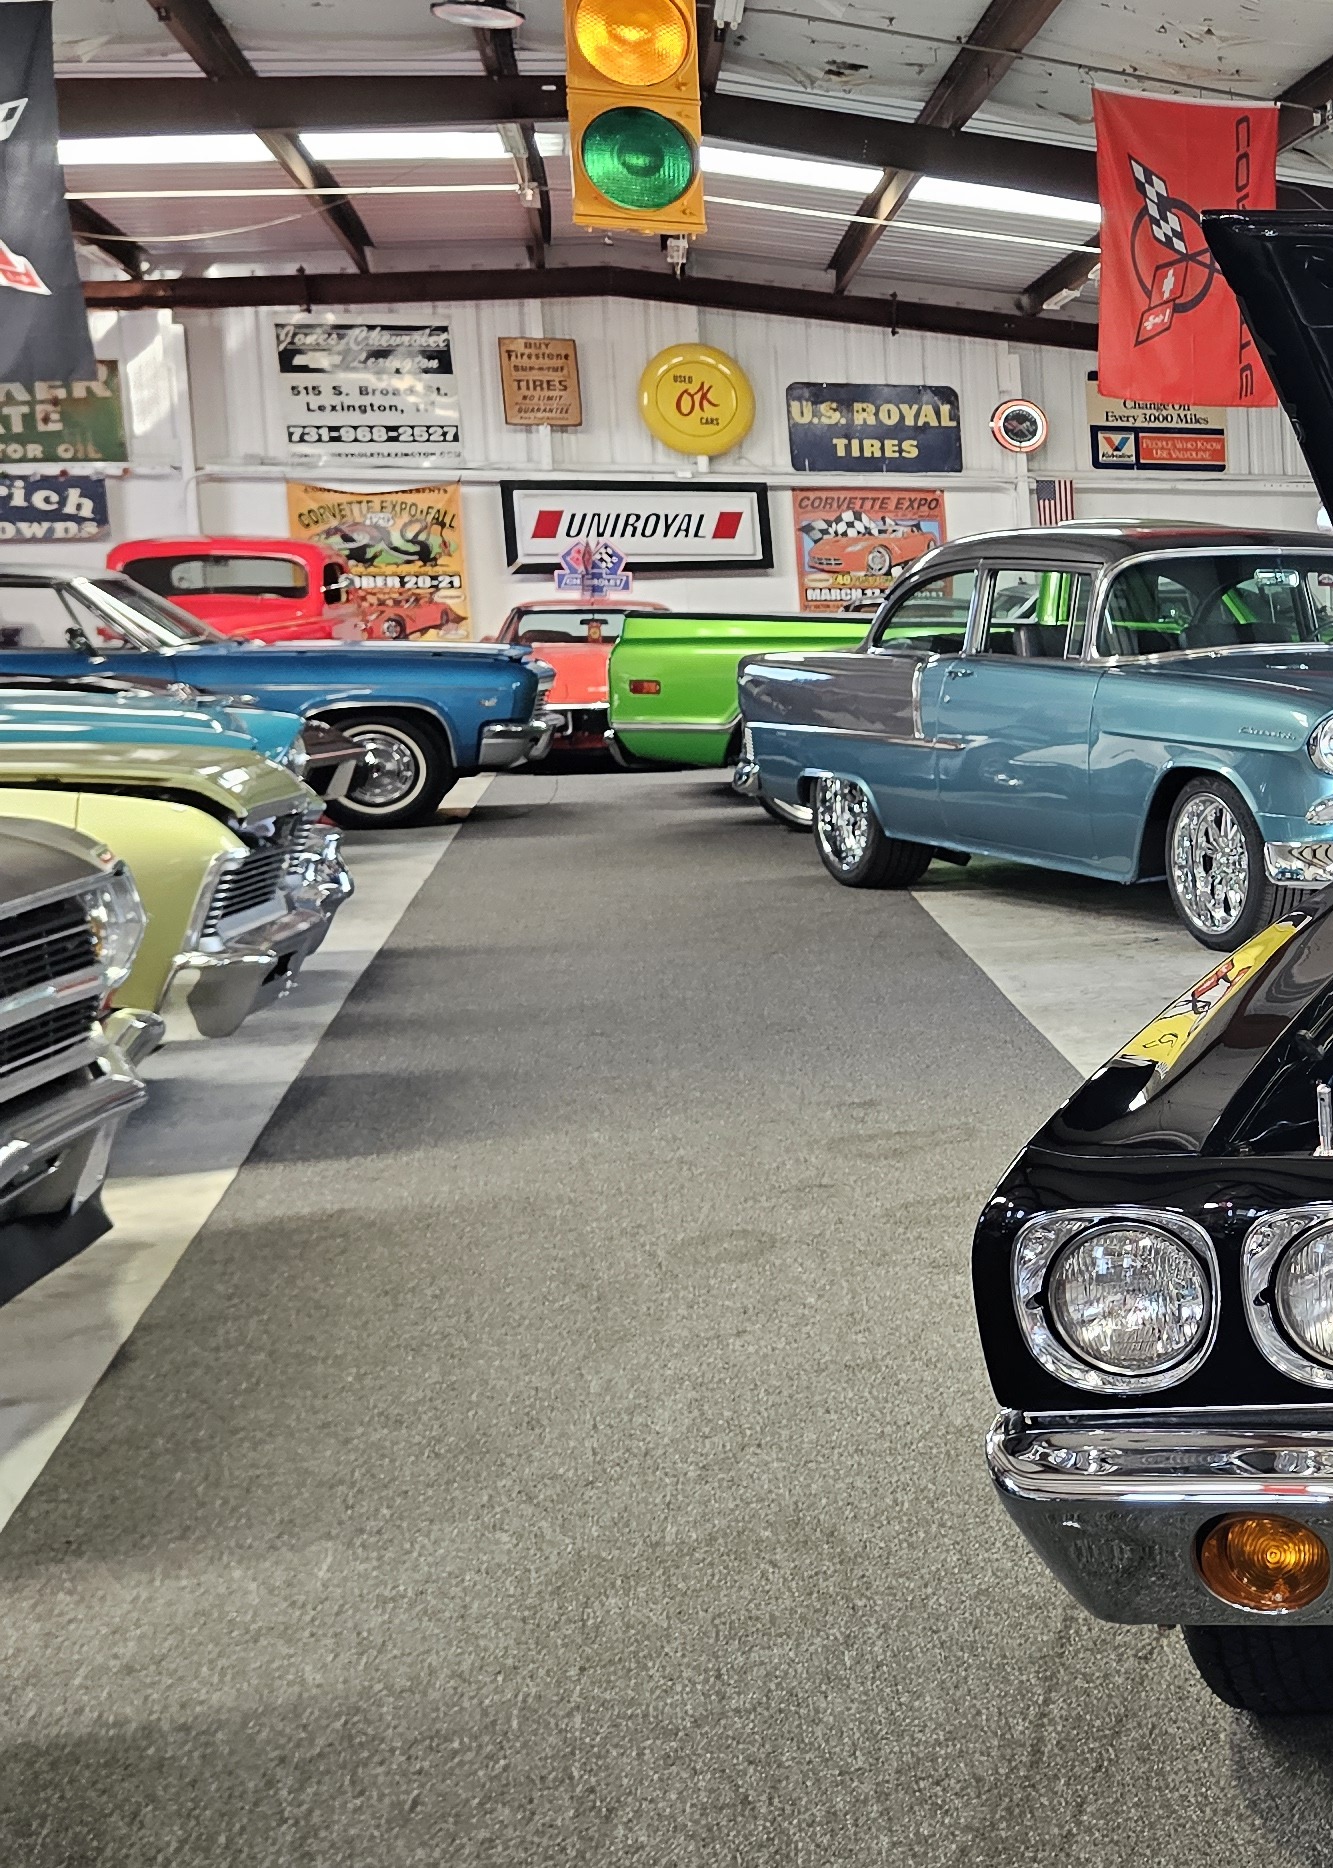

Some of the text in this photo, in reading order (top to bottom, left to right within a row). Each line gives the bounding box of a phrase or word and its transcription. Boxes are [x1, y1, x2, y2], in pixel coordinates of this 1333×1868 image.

[523, 341, 551, 350] BUY
[505, 349, 570, 362] Firestone
[513, 378, 569, 392] TIRES
[673, 374, 694, 385] USED
[290, 385, 323, 397] 515
[332, 385, 350, 397] S.
[675, 381, 721, 417] OK
[305, 401, 405, 415] Lexington,
[790, 400, 957, 427] U.S. ROYAL
[699, 416, 720, 426] CARS
[1104, 411, 1209, 426] Every 3,000 Miles
[288, 425, 459, 443] 731-968-2527
[832, 437, 919, 459] TIRES
[798, 495, 940, 512] CORVETTE EXPO
[297, 499, 376, 530] CORVETTE
[565, 512, 707, 539] UNIROYAL
[403, 575, 461, 588] 20-21
[806, 587, 863, 601] MARCH
